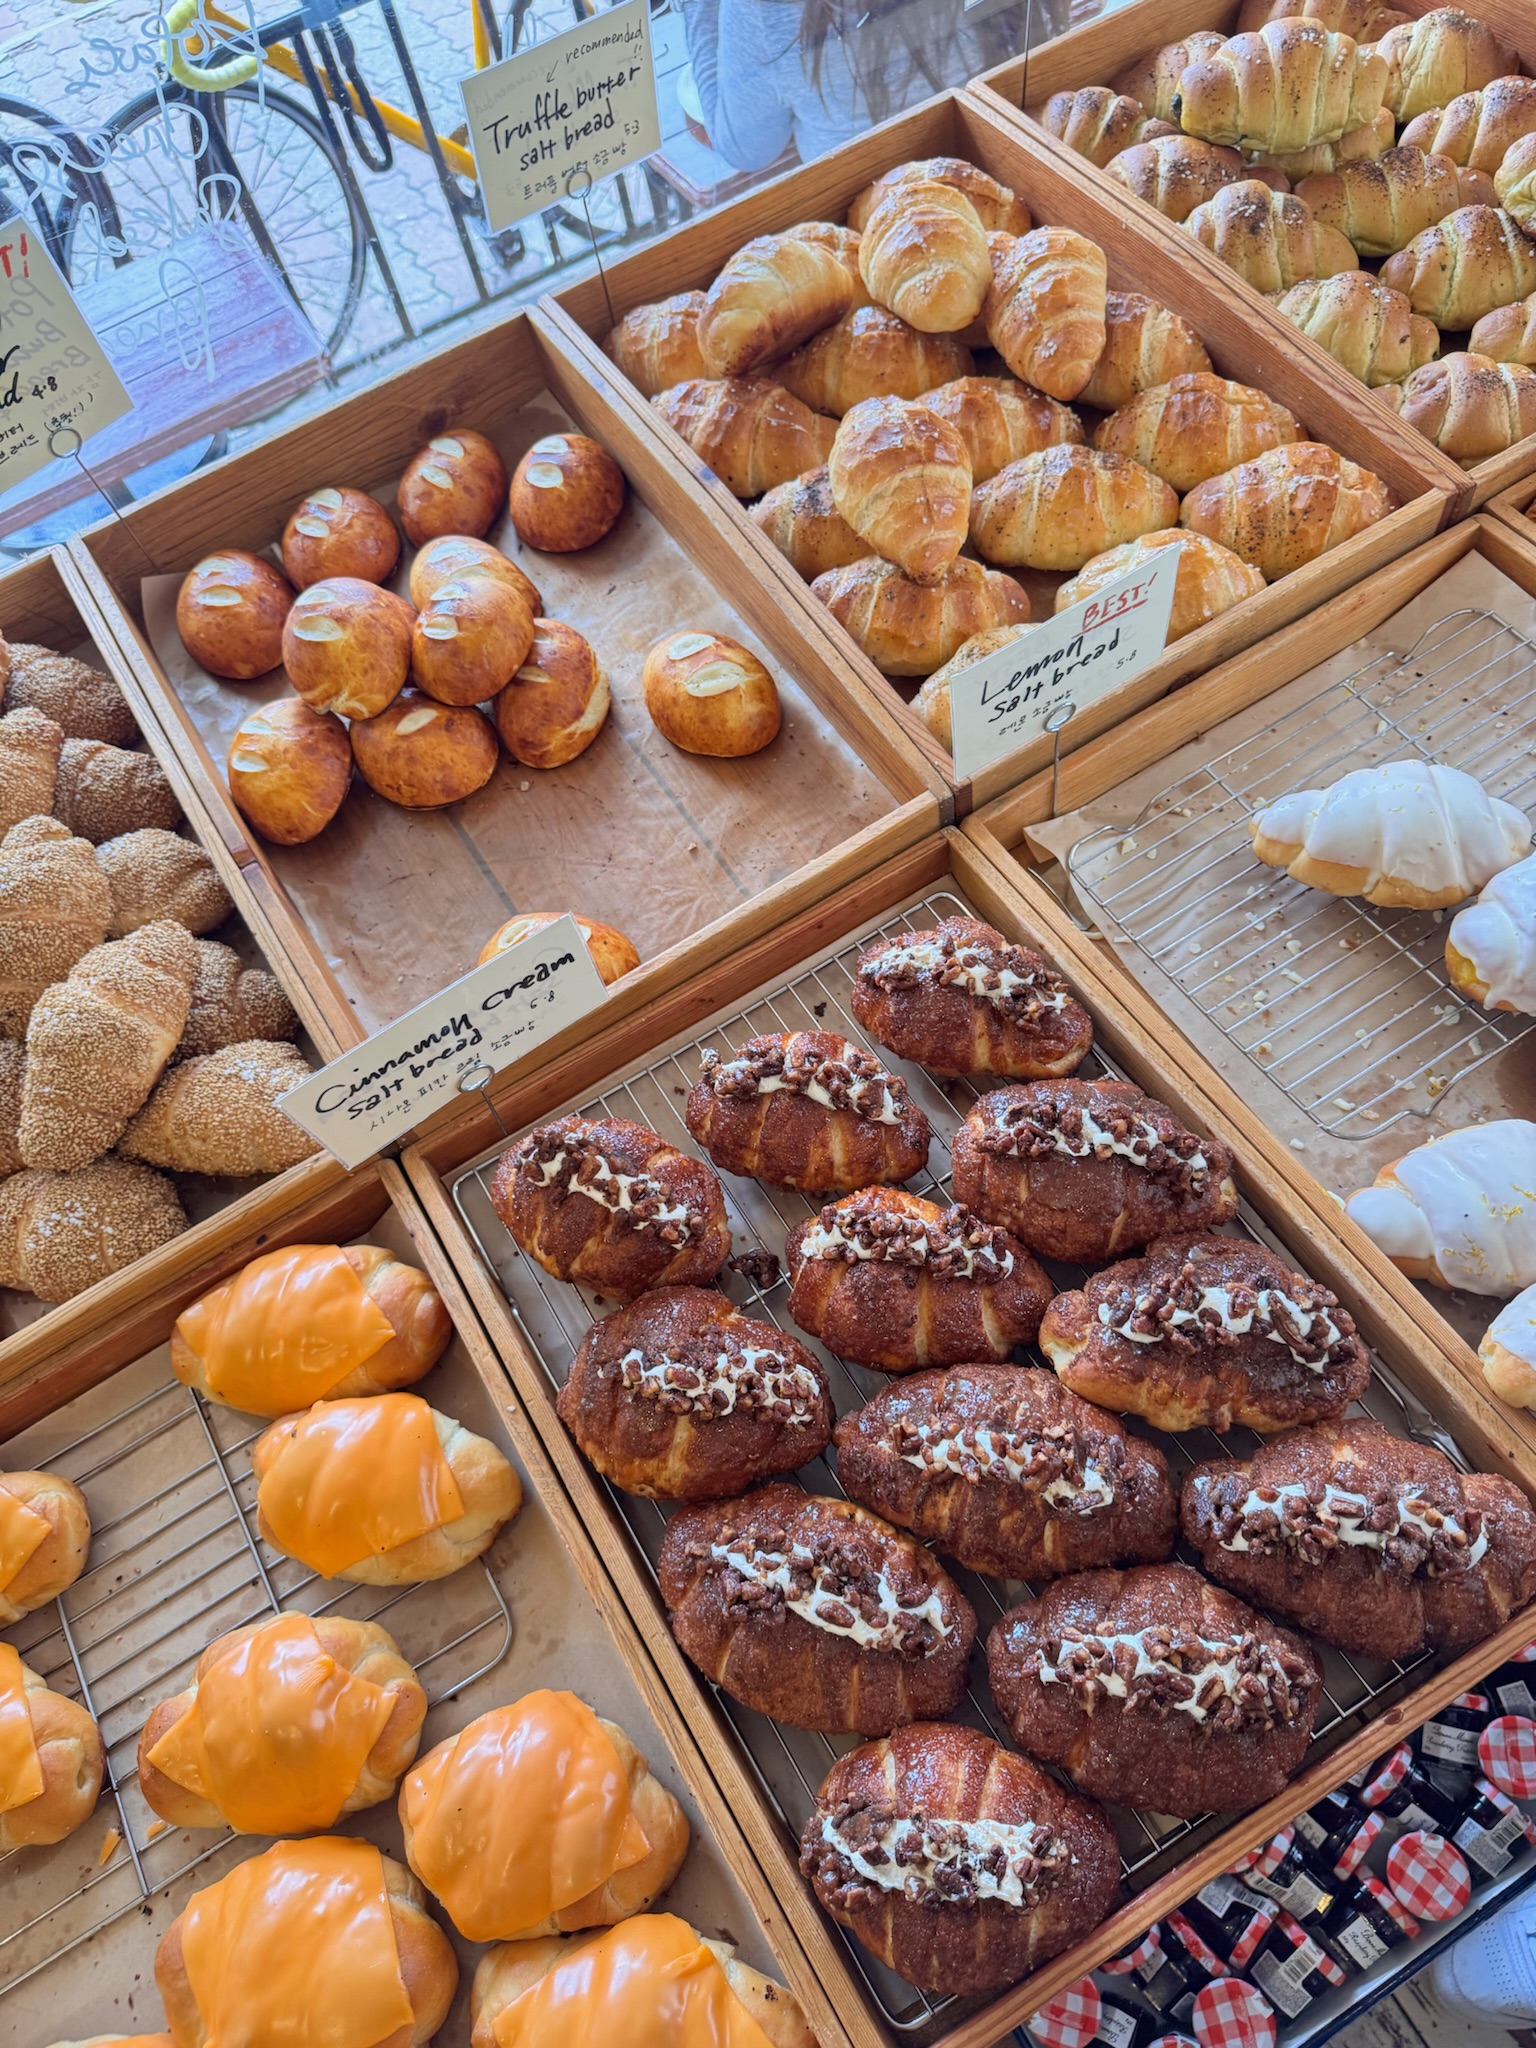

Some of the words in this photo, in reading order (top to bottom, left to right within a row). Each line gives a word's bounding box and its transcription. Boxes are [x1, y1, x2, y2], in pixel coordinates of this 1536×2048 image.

[565, 19, 644, 64] recommended
[482, 88, 573, 154] Truffle
[576, 66, 641, 109] butter
[520, 138, 557, 171] salt
[564, 97, 614, 150] bread
[1082, 572, 1159, 630] BEST!
[980, 635, 1084, 706] Lemon
[1052, 627, 1120, 686] bread
[410, 1028, 483, 1078] bread
